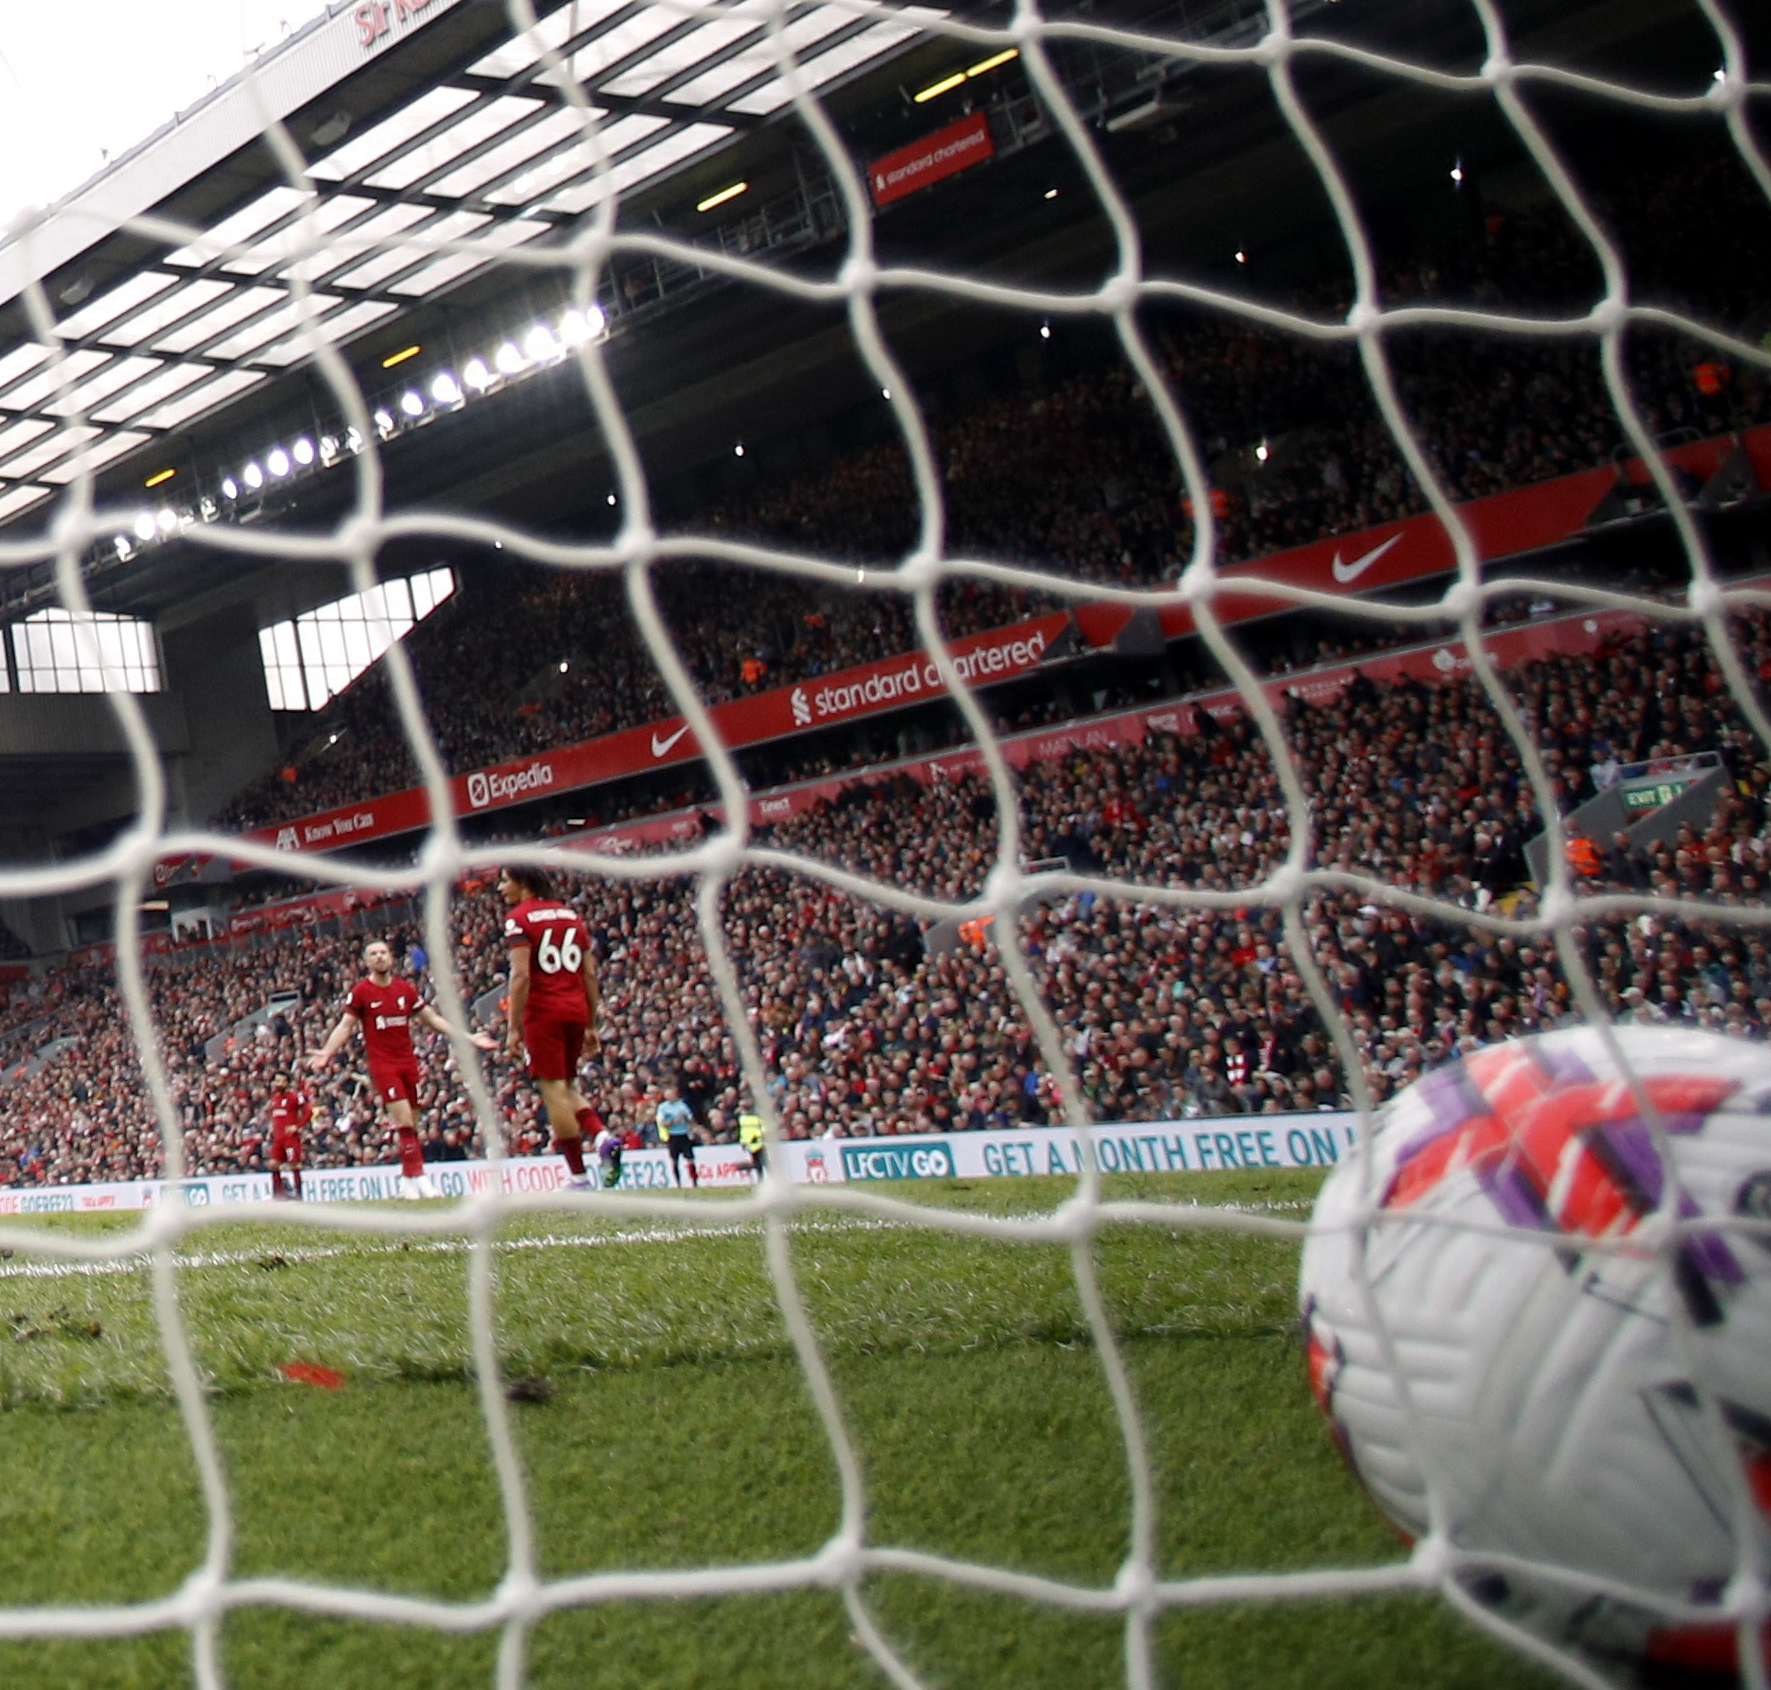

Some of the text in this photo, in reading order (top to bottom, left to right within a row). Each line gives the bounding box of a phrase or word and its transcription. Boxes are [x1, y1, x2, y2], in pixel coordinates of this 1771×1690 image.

[813, 662, 923, 717] standard
[488, 762, 553, 798] Expedia
[538, 926, 582, 975] 66
[845, 1148, 949, 1179] LFCTV GO
[983, 1141, 1034, 1177] GET
[1048, 1140, 1069, 1175] A
[1194, 1130, 1280, 1170] FREE
[1287, 1126, 1339, 1167] ON
[320, 1178, 357, 1202] FREE
[358, 1177, 382, 1201] ON
[440, 1172, 465, 1197] GO
[467, 1167, 513, 1195] WIH
[517, 1165, 565, 1193] CODE
[586, 1161, 670, 1191] OEE23
[717, 1161, 752, 1179] APP
